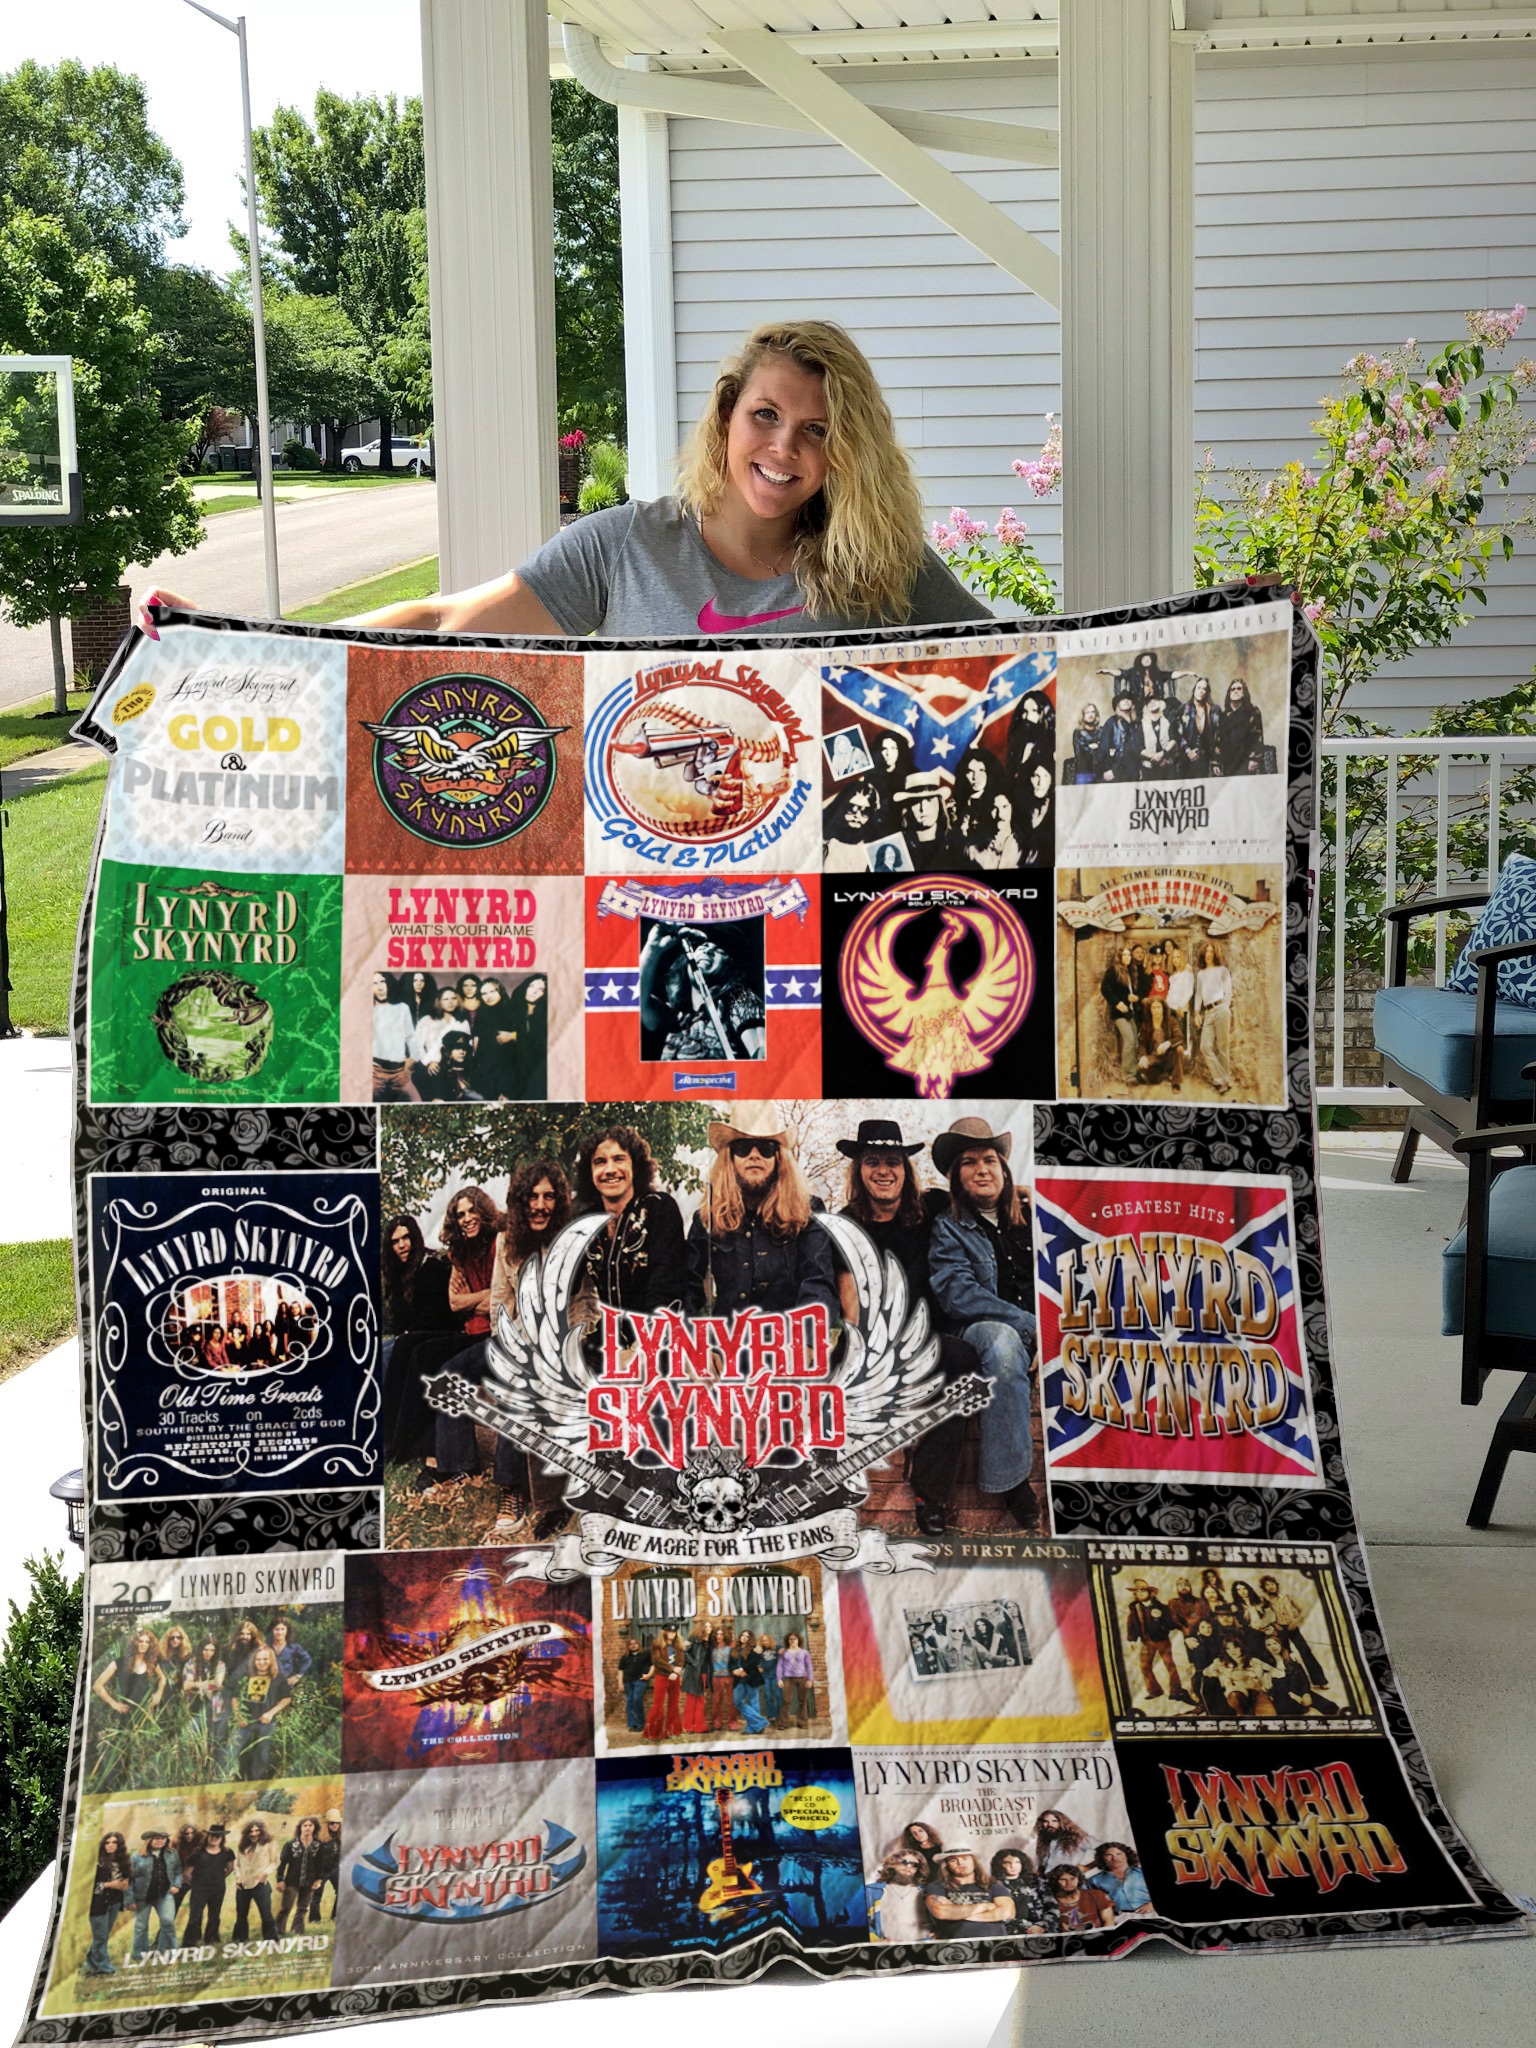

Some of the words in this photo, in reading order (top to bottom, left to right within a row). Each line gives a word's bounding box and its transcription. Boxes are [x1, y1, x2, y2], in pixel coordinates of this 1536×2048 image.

[12, 489, 60, 501] SPALDING
[1066, 629, 1164, 650] EXTENDED
[1182, 611, 1278, 636] VERSIONS
[828, 646, 922, 663] LYNYRD
[944, 636, 1055, 656] SKYNYRD
[912, 662, 970, 672] LEGEND
[163, 669, 228, 703] Lynyrd
[228, 669, 300, 704] Skynyrd
[121, 696, 144, 713] TWO
[410, 687, 523, 723] LYNYRD
[634, 659, 726, 700] Lynyrd
[736, 664, 814, 748] Skynyrd
[168, 714, 301, 752] GOLD
[221, 753, 246, 771] &
[123, 757, 338, 811] PLATINUM
[1134, 785, 1206, 812] LYNYRD
[202, 819, 254, 846] Band
[602, 818, 672, 863] Gold
[672, 848, 699, 867] &
[704, 779, 812, 867] Platinum
[1129, 806, 1210, 835] SKYNYRD
[1100, 878, 1119, 892] ALL
[1122, 869, 1150, 882] TIME
[1154, 868, 1208, 882] GREATEST
[1210, 876, 1234, 893] HITS
[134, 882, 298, 933] LYNYRD
[388, 888, 537, 924] LYNYRD
[642, 896, 696, 919] LYNYRD
[702, 895, 765, 919] SKYNYRD
[834, 890, 923, 902] LYNYRD
[930, 888, 1038, 900] SKYNYRD
[1105, 881, 1159, 915] LYNYRD
[1165, 881, 1228, 917] SKYNYRD
[389, 925, 443, 936] WHAT'S
[448, 925, 488, 936] YOUR
[493, 926, 534, 936] NAME
[133, 928, 297, 964] SKYNYRD
[387, 936, 537, 968] SKYNYRD
[201, 1186, 266, 1197] ORIGINAL
[1101, 1200, 1182, 1219] GREATEST
[1189, 1204, 1225, 1225] HITS
[121, 1227, 227, 1297] LYNYRD
[233, 1218, 350, 1289] SKYNYRD
[1056, 1232, 1280, 1340] LYNYRD
[599, 1302, 833, 1385] LYNYRD
[158, 1384, 199, 1410] Old
[200, 1381, 256, 1407] Time
[259, 1380, 324, 1405] Greats
[1061, 1334, 1289, 1437] SKYNYRD
[136, 1425, 204, 1437] SOUTHERN
[208, 1424, 225, 1433] BY
[228, 1424, 252, 1432] THE
[255, 1422, 297, 1431] GRACE
[300, 1420, 316, 1429] OF
[319, 1419, 346, 1428] GOD
[158, 1412, 175, 1426] 30
[178, 1410, 220, 1424] Tracks
[246, 1411, 263, 1422] on
[292, 1406, 323, 1420] 2cds
[586, 1375, 847, 1470] SKYNYRD
[164, 1440, 251, 1451] REPERTOIRE
[258, 1437, 319, 1447] RECORDS
[186, 1433, 230, 1442] DISTILLED
[253, 1445, 312, 1453] GERMANY
[604, 1528, 641, 1551] ONE
[644, 1537, 699, 1557] MORE
[704, 1538, 738, 1557] FOR
[743, 1534, 785, 1554] THE
[788, 1526, 834, 1550] FANS
[961, 1544, 1016, 1558] FIRST
[1087, 1543, 1189, 1561] LYNYRD
[1207, 1545, 1330, 1565] SKYNYRD
[180, 1572, 246, 1598] LYNYRD
[255, 1567, 335, 1594] SKYNYRD
[100, 1607, 134, 1615] CENTURY
[611, 1578, 697, 1620] LYNYRD
[706, 1576, 813, 1617] SKYNYRD
[378, 1657, 457, 1687] LYNYRD
[458, 1623, 552, 1666] SKYNYRD
[447, 1733, 519, 1743] COLLECTION
[1115, 1719, 1378, 1733] COLLECTYBLES
[671, 1751, 774, 1775] LYNYRD
[861, 1759, 971, 1795] LYNYRD
[977, 1756, 1113, 1790] SKYNYRD
[666, 1769, 782, 1794] SKYNYRD
[976, 1788, 997, 1796] THE
[1159, 1761, 1369, 1829] LYNYRD
[433, 1804, 508, 1831] THYRTY
[783, 1808, 837, 1816] SPECIALLY
[940, 1796, 1036, 1813] BROADCAST
[957, 1812, 1028, 1828] ARCHIVE
[398, 1834, 543, 1876] LYNYRD
[1165, 1812, 1408, 1897] SKYNYRD
[383, 1865, 553, 1910] SKYNYRD
[122, 1946, 215, 1969] LYNYRD
[222, 1935, 329, 1959] SKYNYRD
[347, 1965, 382, 1974] 30TH
[389, 1954, 490, 1970] ANNIVERSARY
[497, 1944, 586, 1960] COLLECTION
